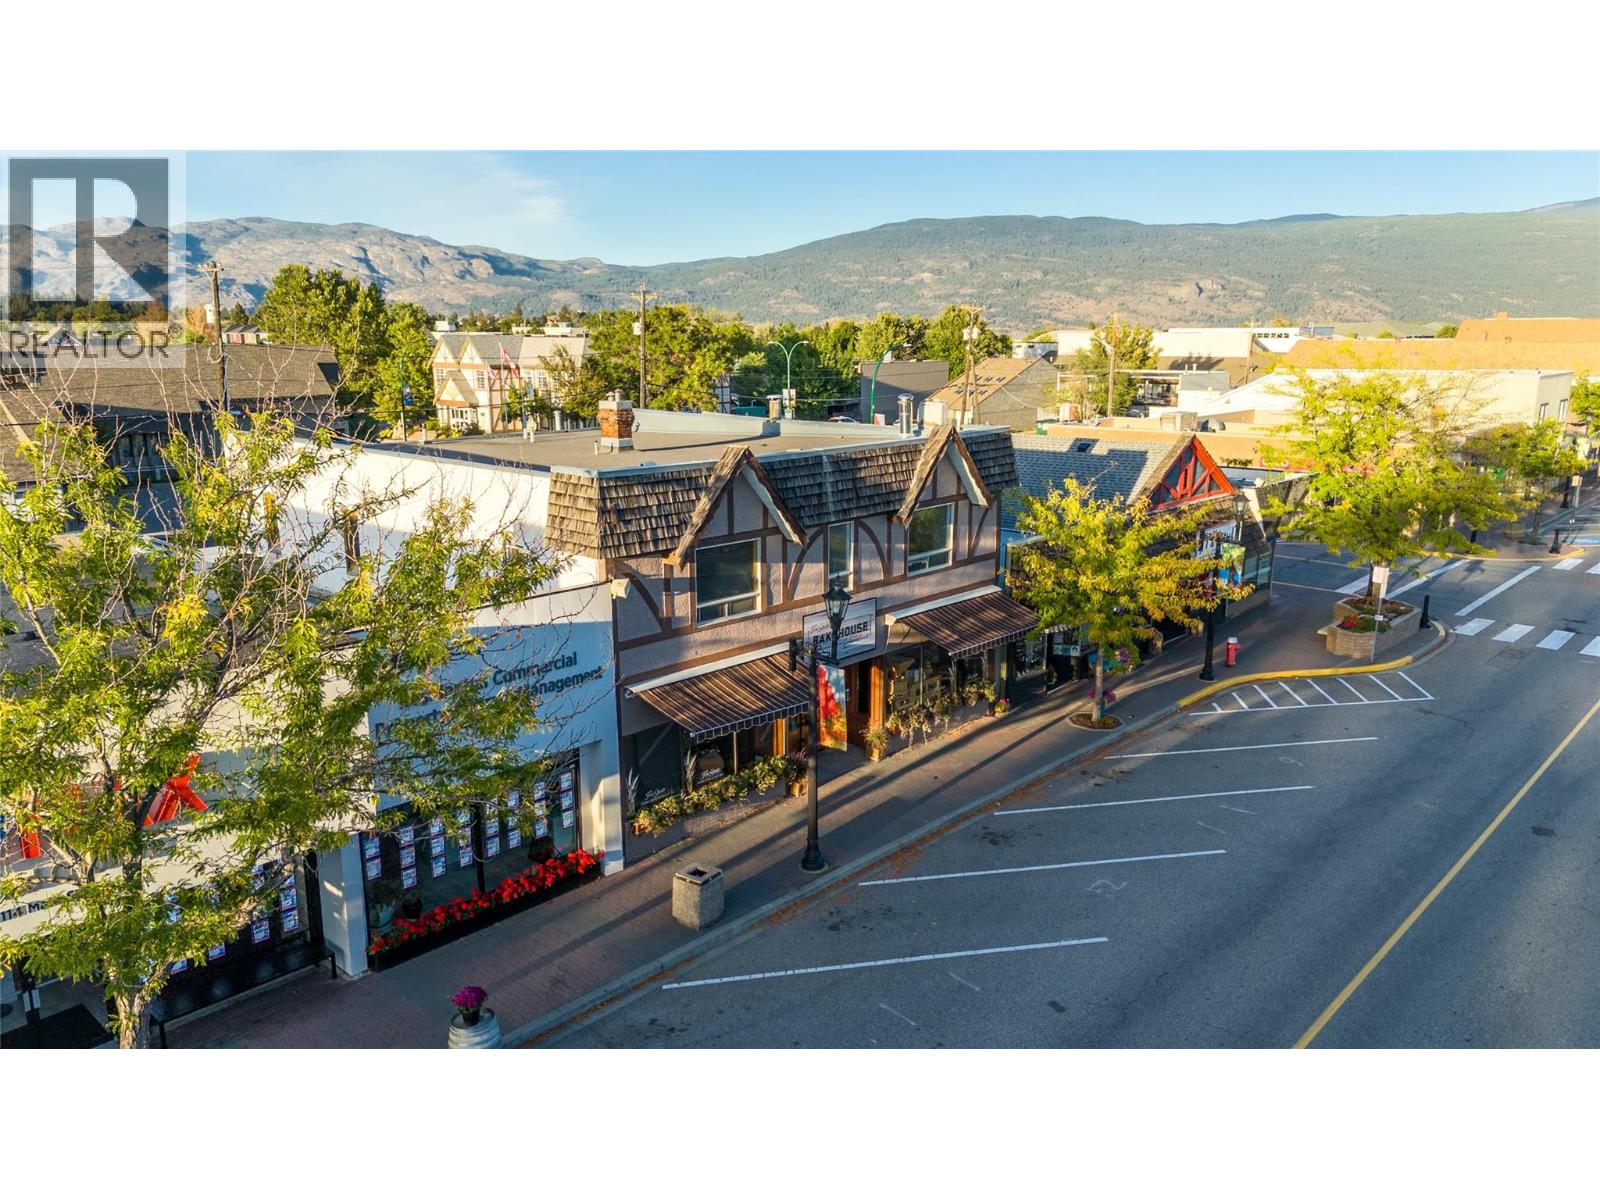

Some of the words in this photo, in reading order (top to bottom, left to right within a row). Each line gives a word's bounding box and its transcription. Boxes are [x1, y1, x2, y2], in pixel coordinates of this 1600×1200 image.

[813, 621, 868, 645] BAKHOUSE
[492, 651, 577, 686] Commercial
[519, 665, 603, 697] anagement
